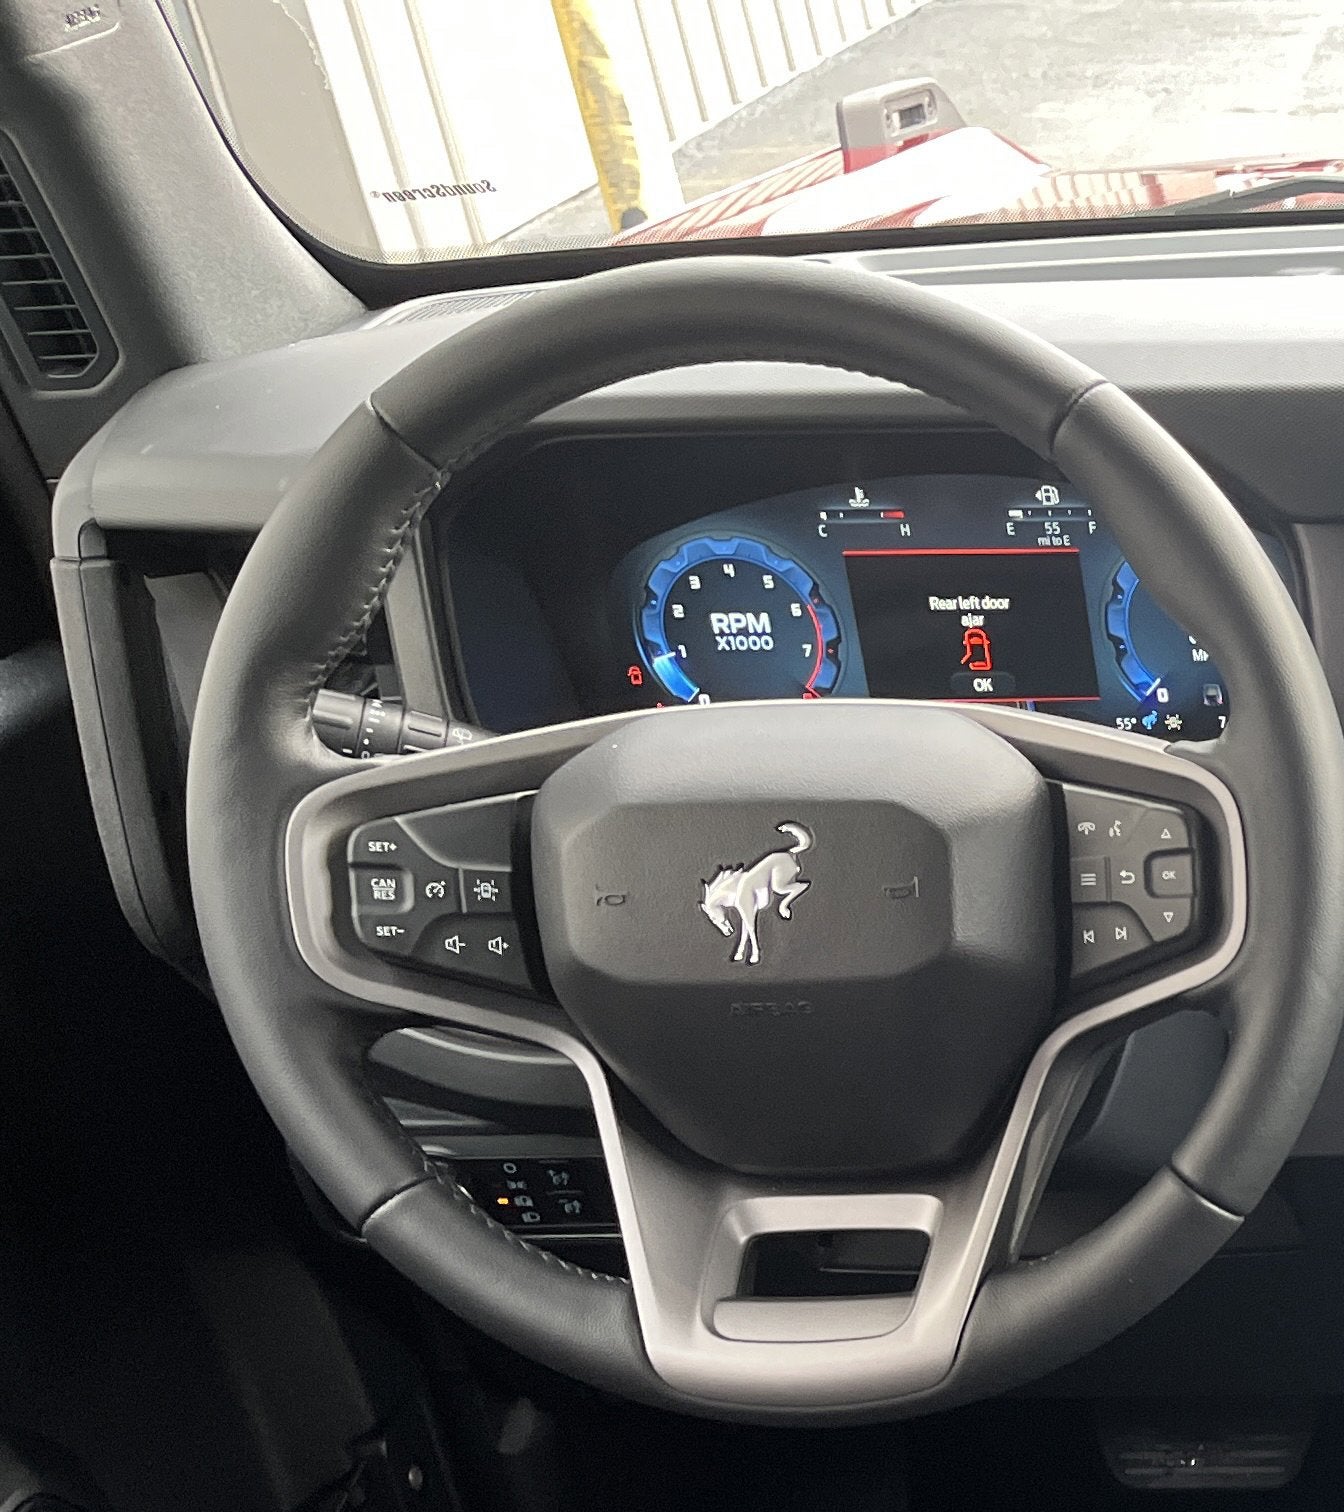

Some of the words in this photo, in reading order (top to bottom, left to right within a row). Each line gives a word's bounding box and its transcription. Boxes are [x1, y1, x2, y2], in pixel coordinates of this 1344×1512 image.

[818, 524, 828, 537] C
[900, 523, 911, 537] H
[1006, 523, 1015, 536] E
[1044, 522, 1060, 535] 55
[1088, 522, 1097, 534] F
[723, 564, 735, 577] 4
[689, 575, 701, 590] 3
[763, 575, 775, 589] 5
[790, 603, 802, 617] 6
[928, 596, 957, 611] Rear
[958, 596, 980, 610] left
[981, 595, 1010, 610] door
[672, 604, 685, 618] 2
[710, 612, 772, 634] RPM
[961, 613, 984, 627] ajar
[716, 635, 774, 651] X1000
[678, 644, 687, 658] 1
[802, 644, 812, 657] 7
[972, 678, 993, 692] OK
[1156, 688, 1169, 703] 0
[1116, 716, 1137, 730] 55°
[1161, 870, 1177, 880] OK
[371, 878, 396, 889] CAN
[373, 889, 396, 900] RES
